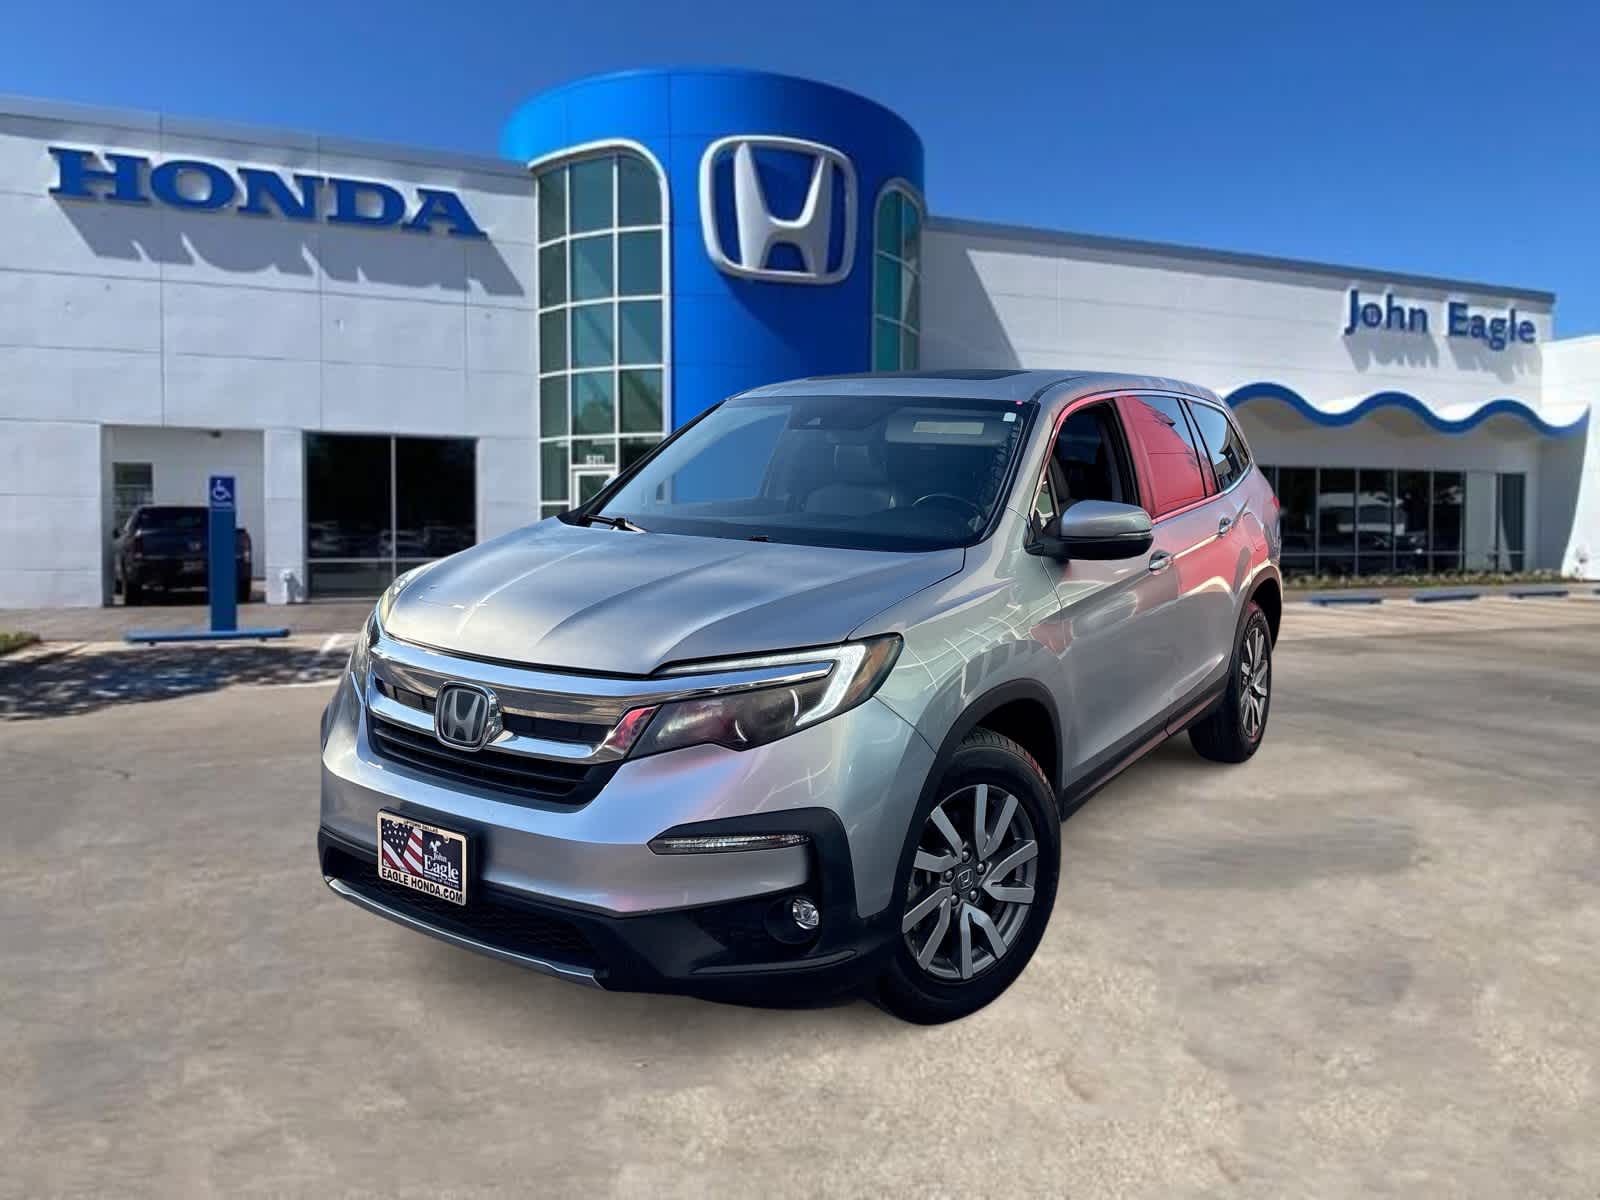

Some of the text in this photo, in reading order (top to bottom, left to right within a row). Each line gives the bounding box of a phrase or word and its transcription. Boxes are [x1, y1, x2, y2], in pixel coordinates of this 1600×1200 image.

[48, 146, 487, 240] HONDA
[1344, 289, 1536, 351] John Eagle
[423, 854, 459, 880] Eagle
[433, 851, 447, 862] John
[382, 867, 409, 888] EAGLE
[411, 879, 462, 904] HONDA.COM
